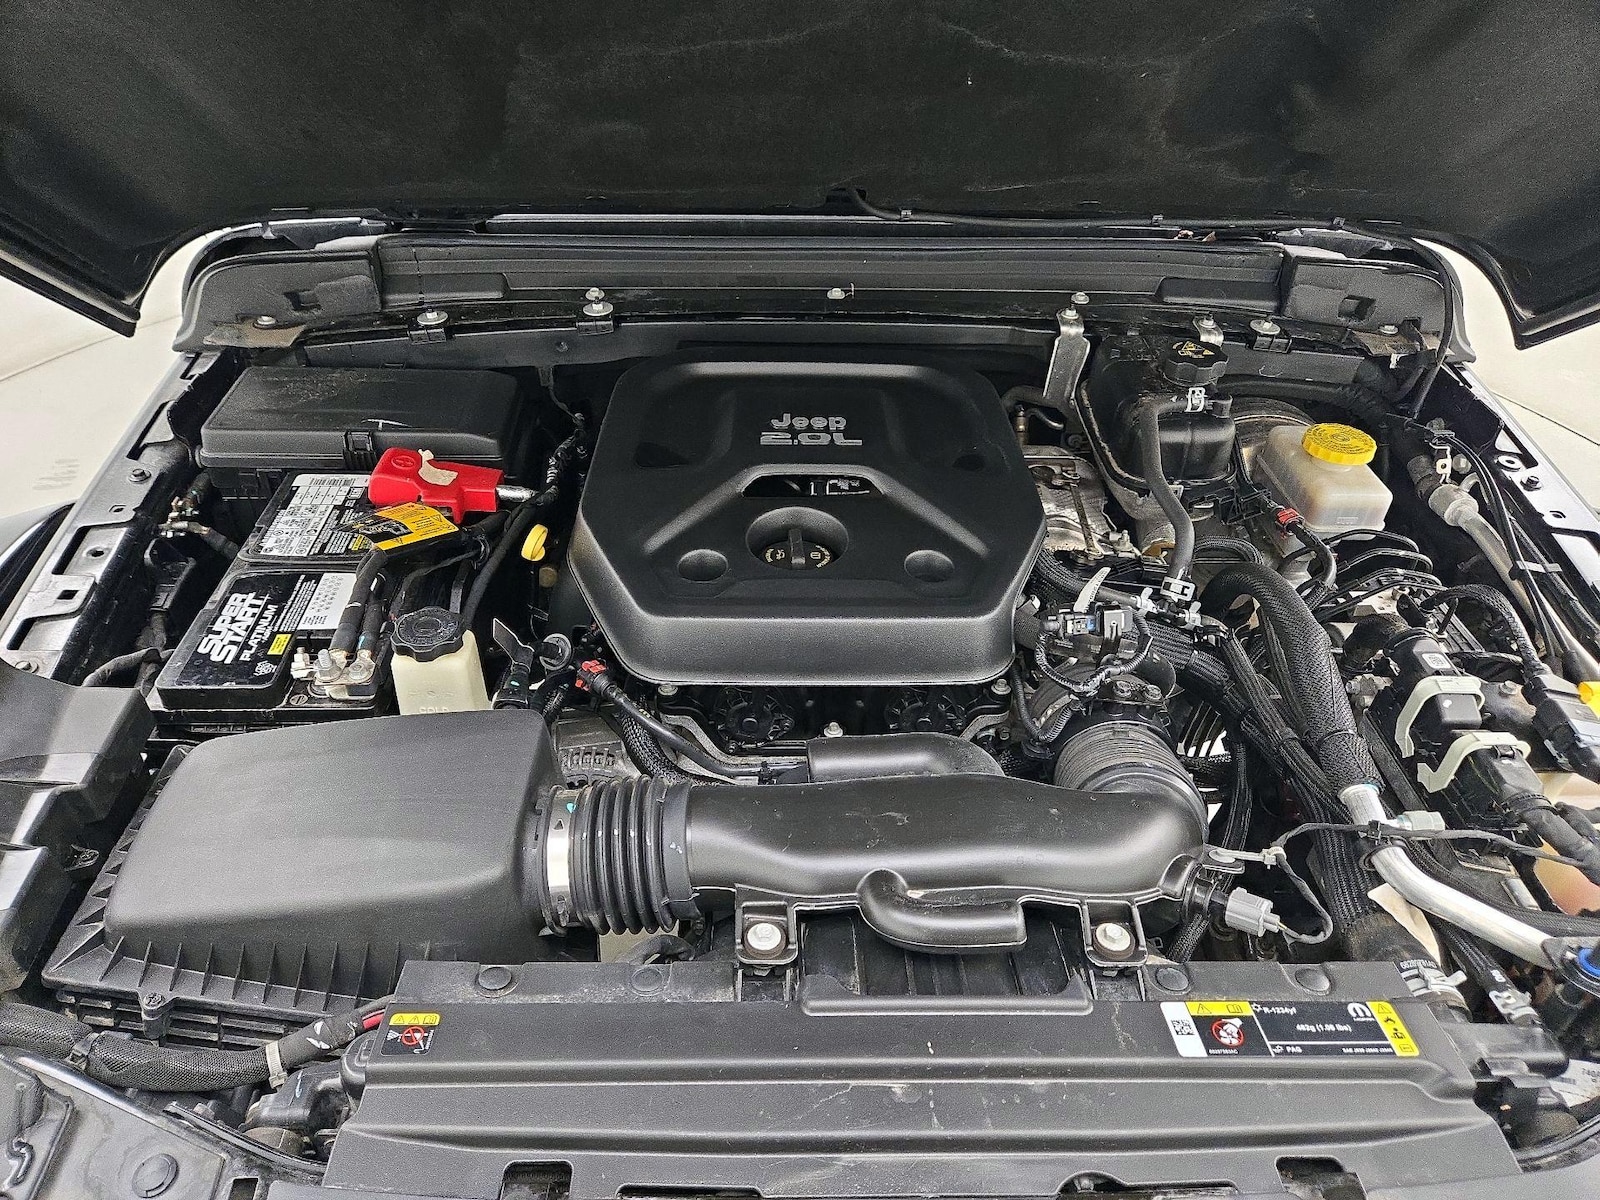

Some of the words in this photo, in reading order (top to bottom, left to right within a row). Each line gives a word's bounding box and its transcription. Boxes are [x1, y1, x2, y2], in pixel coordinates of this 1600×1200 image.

[760, 432, 862, 446] 2.0L
[771, 413, 846, 430] Jeep
[197, 592, 247, 655] SUPER
[209, 591, 259, 664] START
[239, 604, 279, 662] PLATINUM
